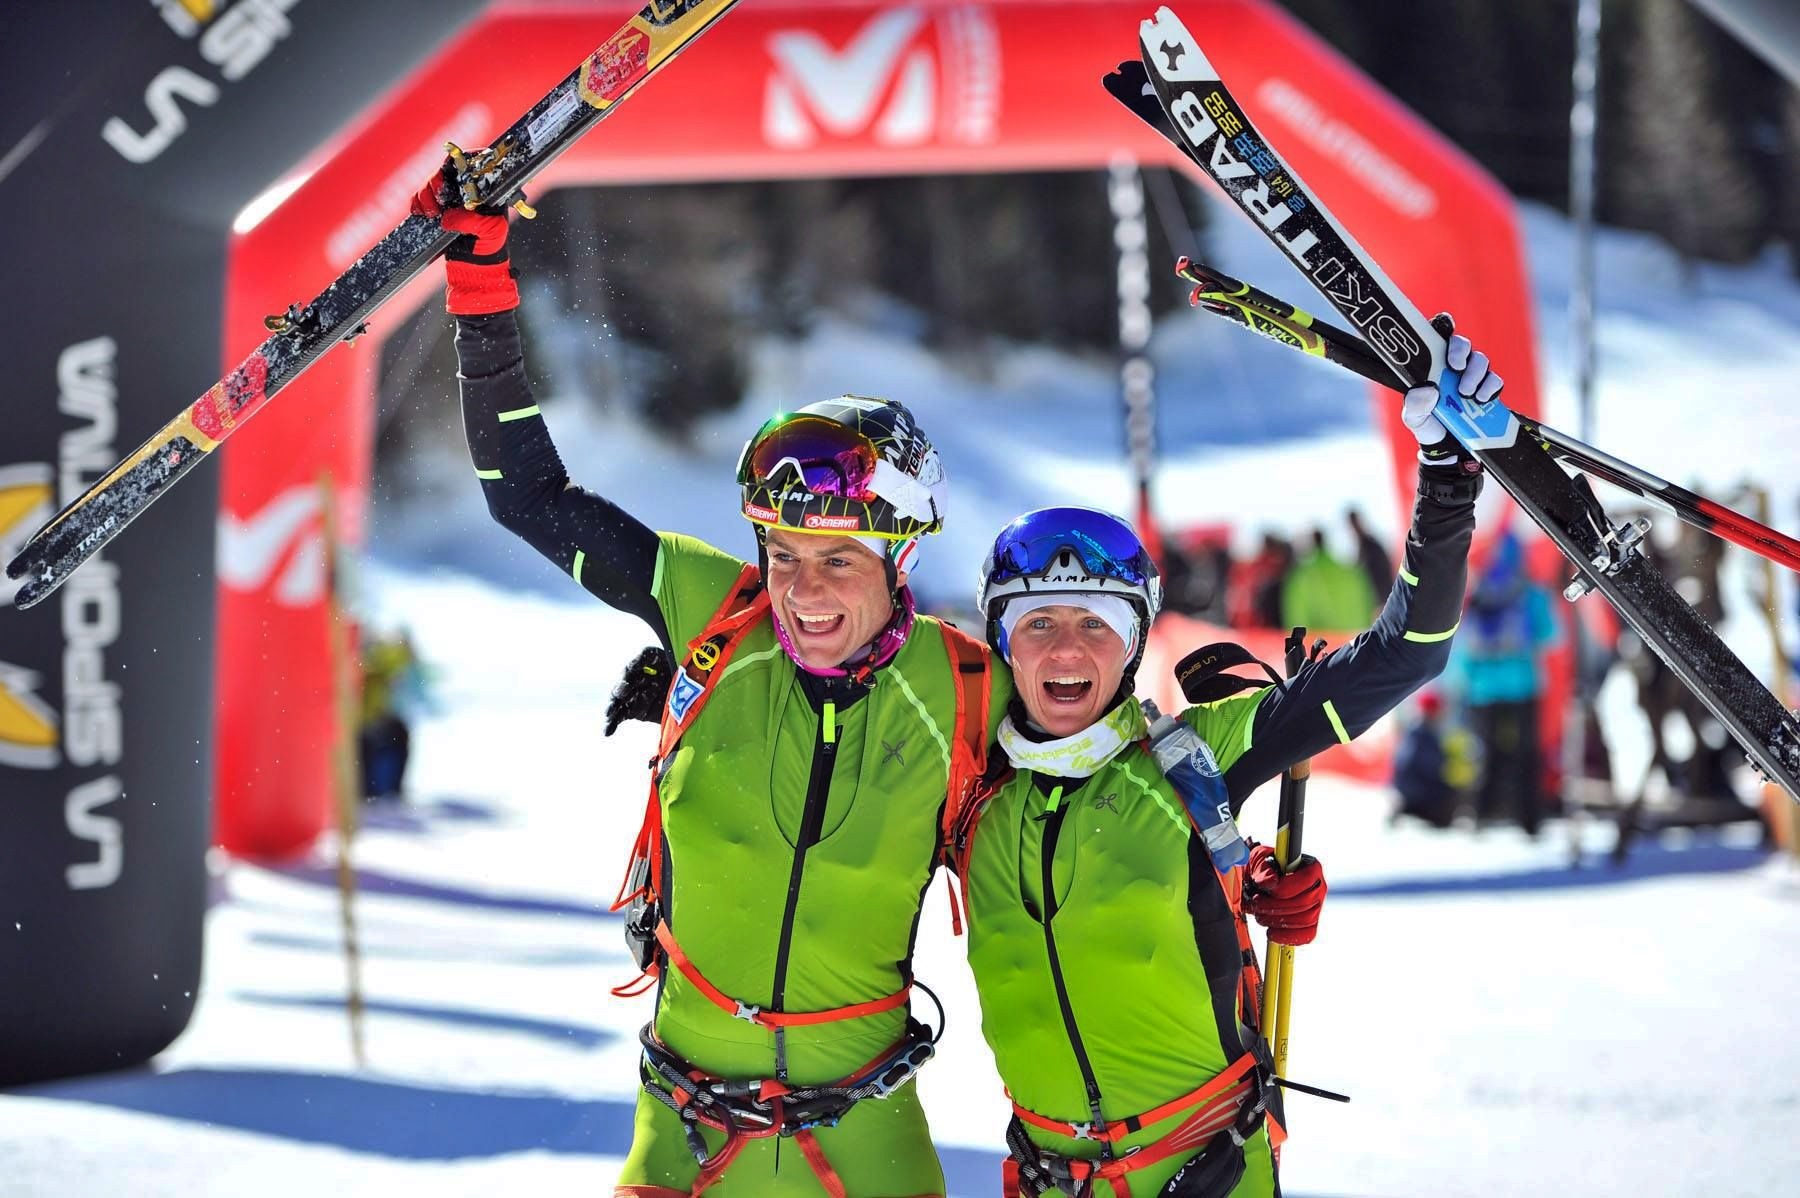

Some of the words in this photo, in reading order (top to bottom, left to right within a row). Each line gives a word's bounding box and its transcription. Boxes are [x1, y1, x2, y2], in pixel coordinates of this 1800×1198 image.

[1170, 90, 1321, 271] TRAB
[1312, 257, 1420, 365] SKI
[770, 489, 815, 503] CAMP
[752, 508, 778, 521] ENERVIT
[821, 518, 858, 529] ENERVIT
[76, 515, 116, 552] TRAB
[57, 335, 123, 767] SPOTIVA
[1041, 575, 1091, 584] CAMP
